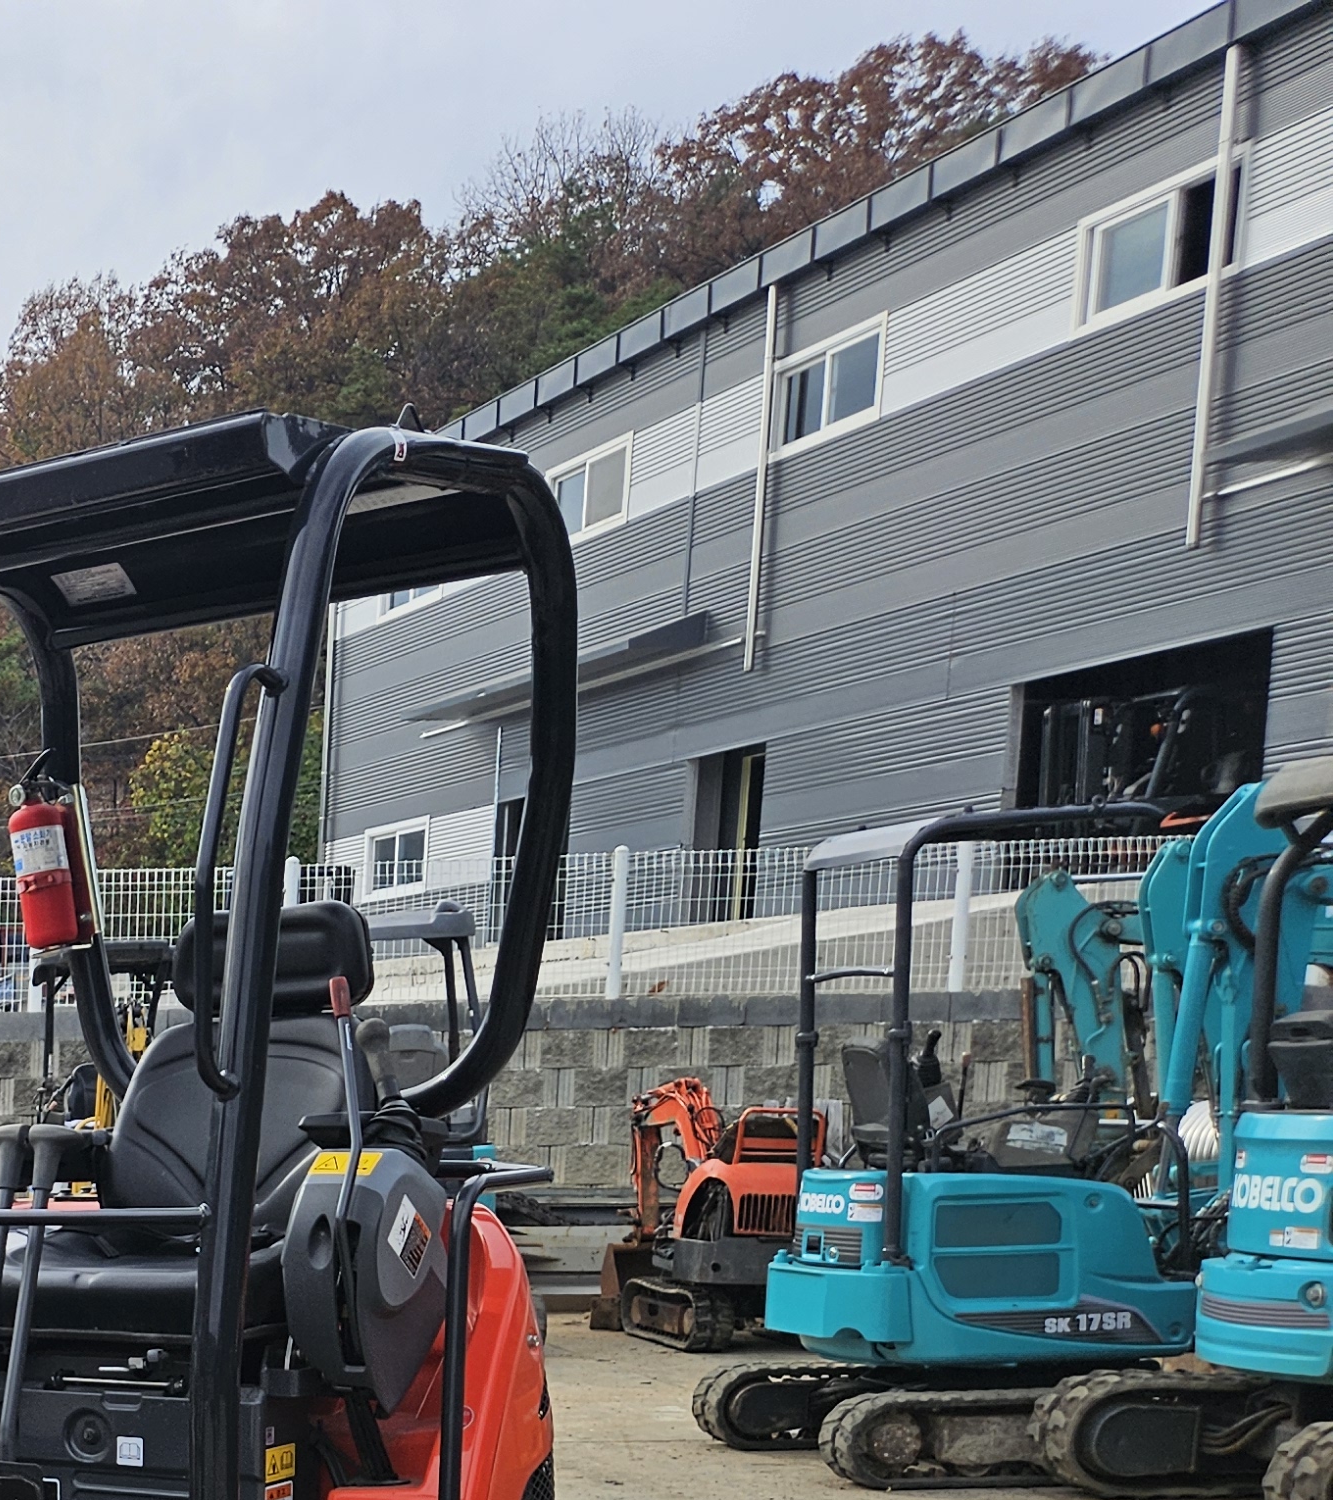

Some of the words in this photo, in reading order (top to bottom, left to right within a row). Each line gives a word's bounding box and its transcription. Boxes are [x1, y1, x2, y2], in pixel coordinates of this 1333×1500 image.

[798, 1192, 845, 1214] OBELCO
[1232, 1174, 1323, 1213] KOBELCO
[1044, 1318, 1071, 1333] SK
[1076, 1311, 1132, 1332] 17SR
